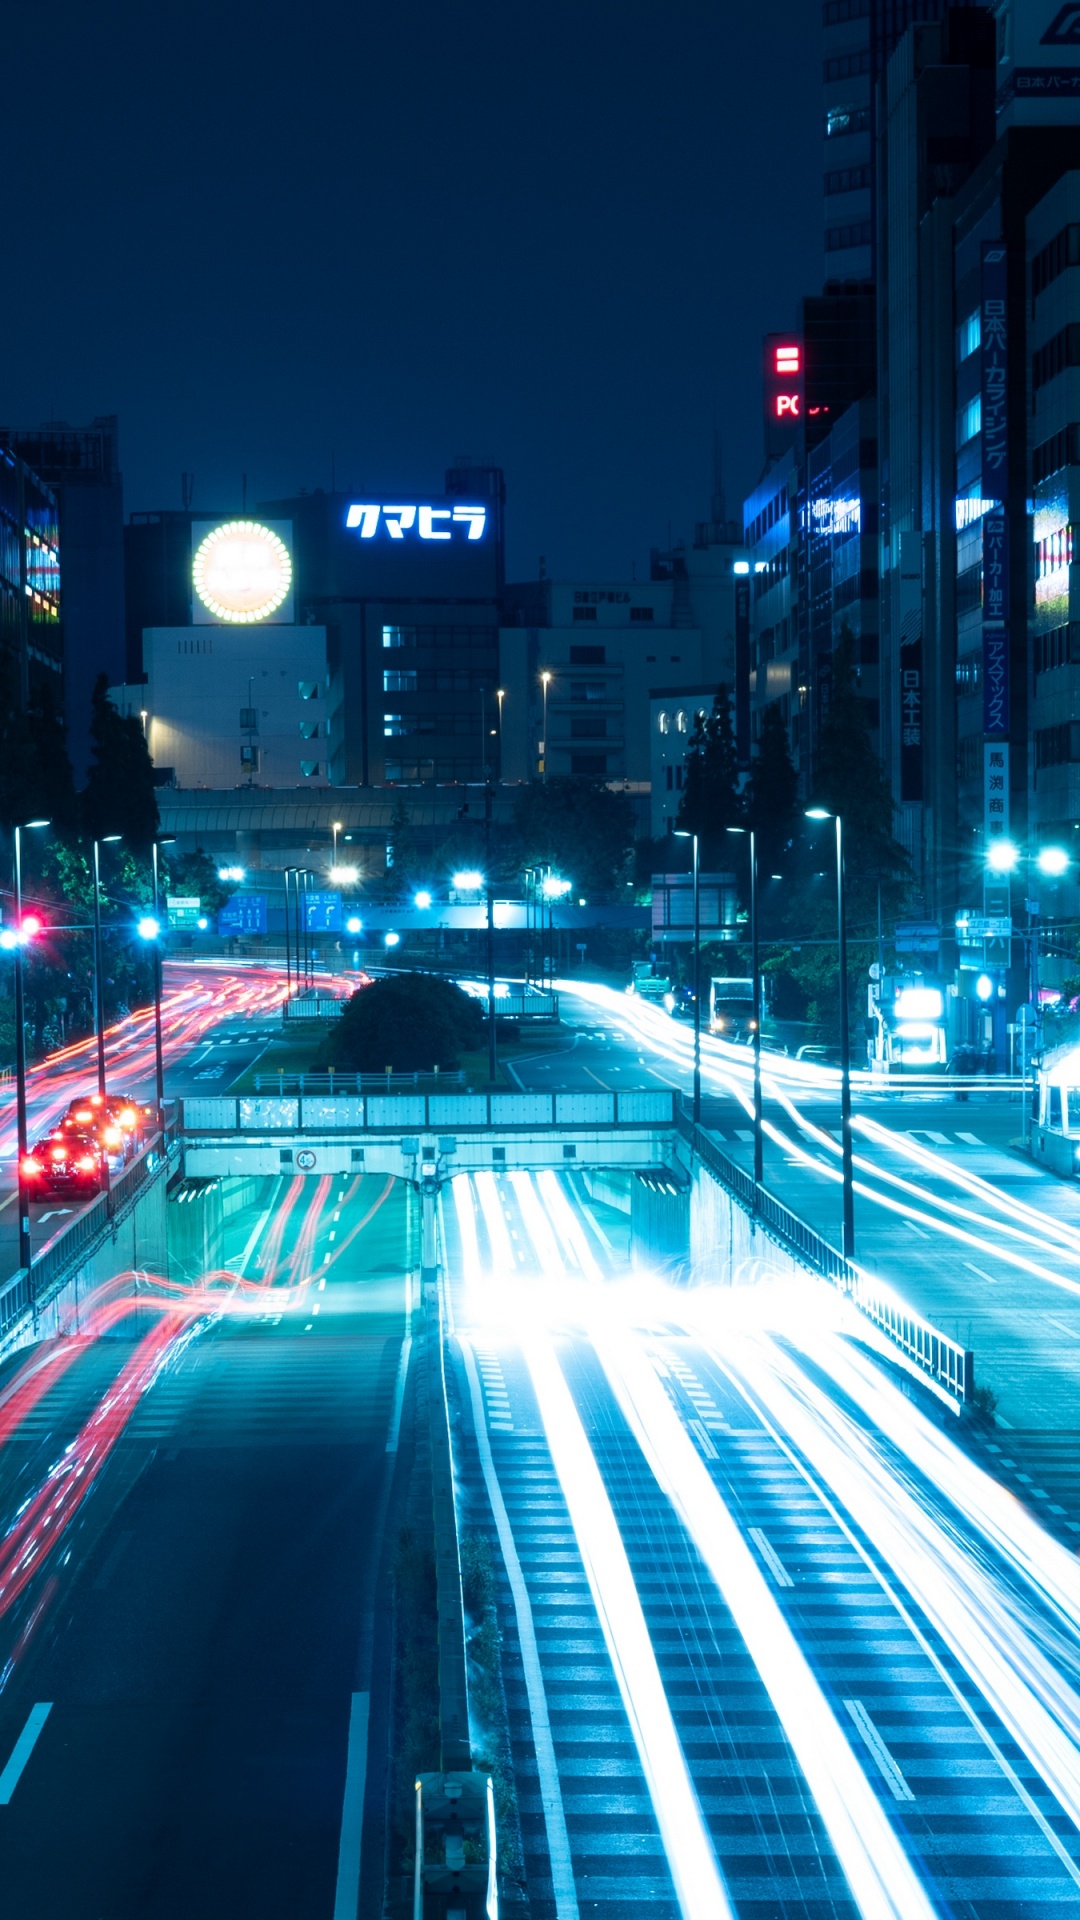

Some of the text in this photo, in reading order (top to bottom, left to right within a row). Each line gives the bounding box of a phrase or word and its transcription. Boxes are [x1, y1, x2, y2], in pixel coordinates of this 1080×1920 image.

[984, 299, 1006, 469] 日本パーカライジング
[346, 504, 486, 540] クマヒラ
[988, 536, 1003, 616] パーカー加工
[903, 670, 920, 746] 日本工装
[988, 641, 1004, 729] アズマックス
